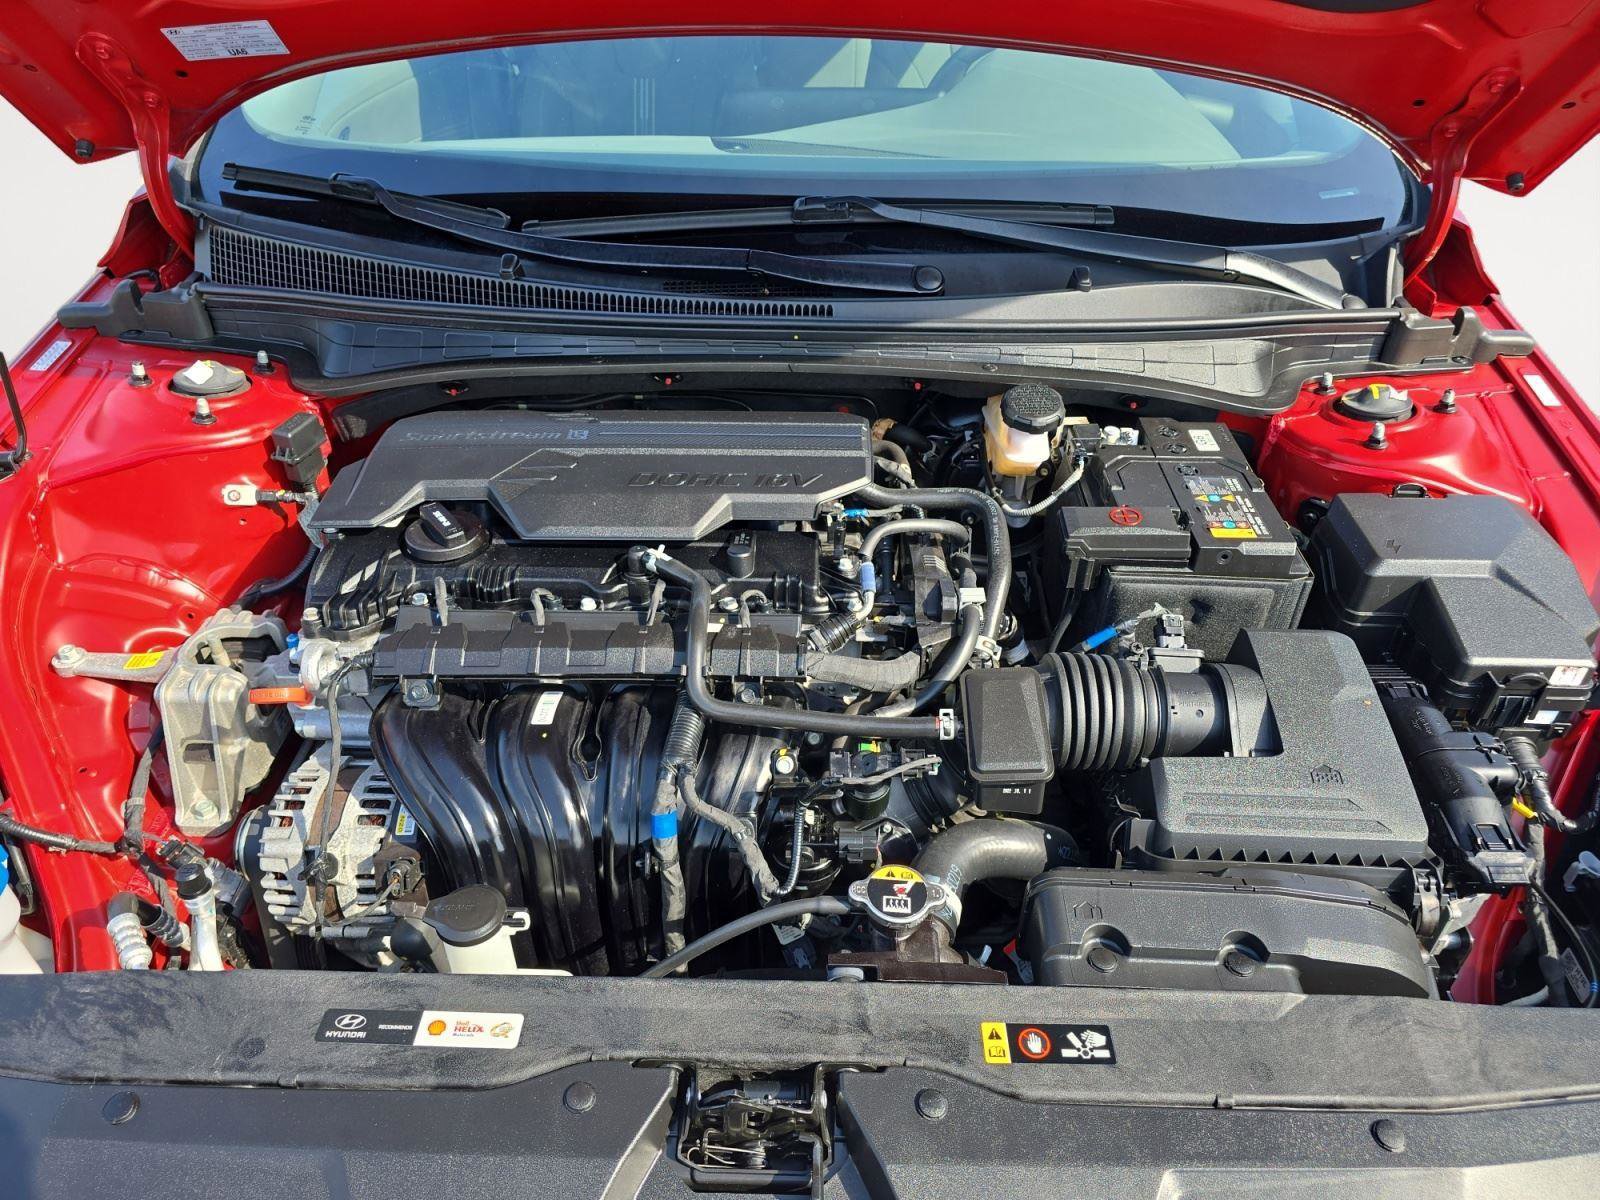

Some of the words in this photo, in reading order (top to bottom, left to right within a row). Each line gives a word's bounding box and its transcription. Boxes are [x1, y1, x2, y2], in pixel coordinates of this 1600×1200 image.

[628, 472, 748, 487] DOHC
[753, 472, 824, 488] 16V
[454, 1024, 484, 1033] HELIX
[325, 1030, 367, 1039] HYUNDAI
